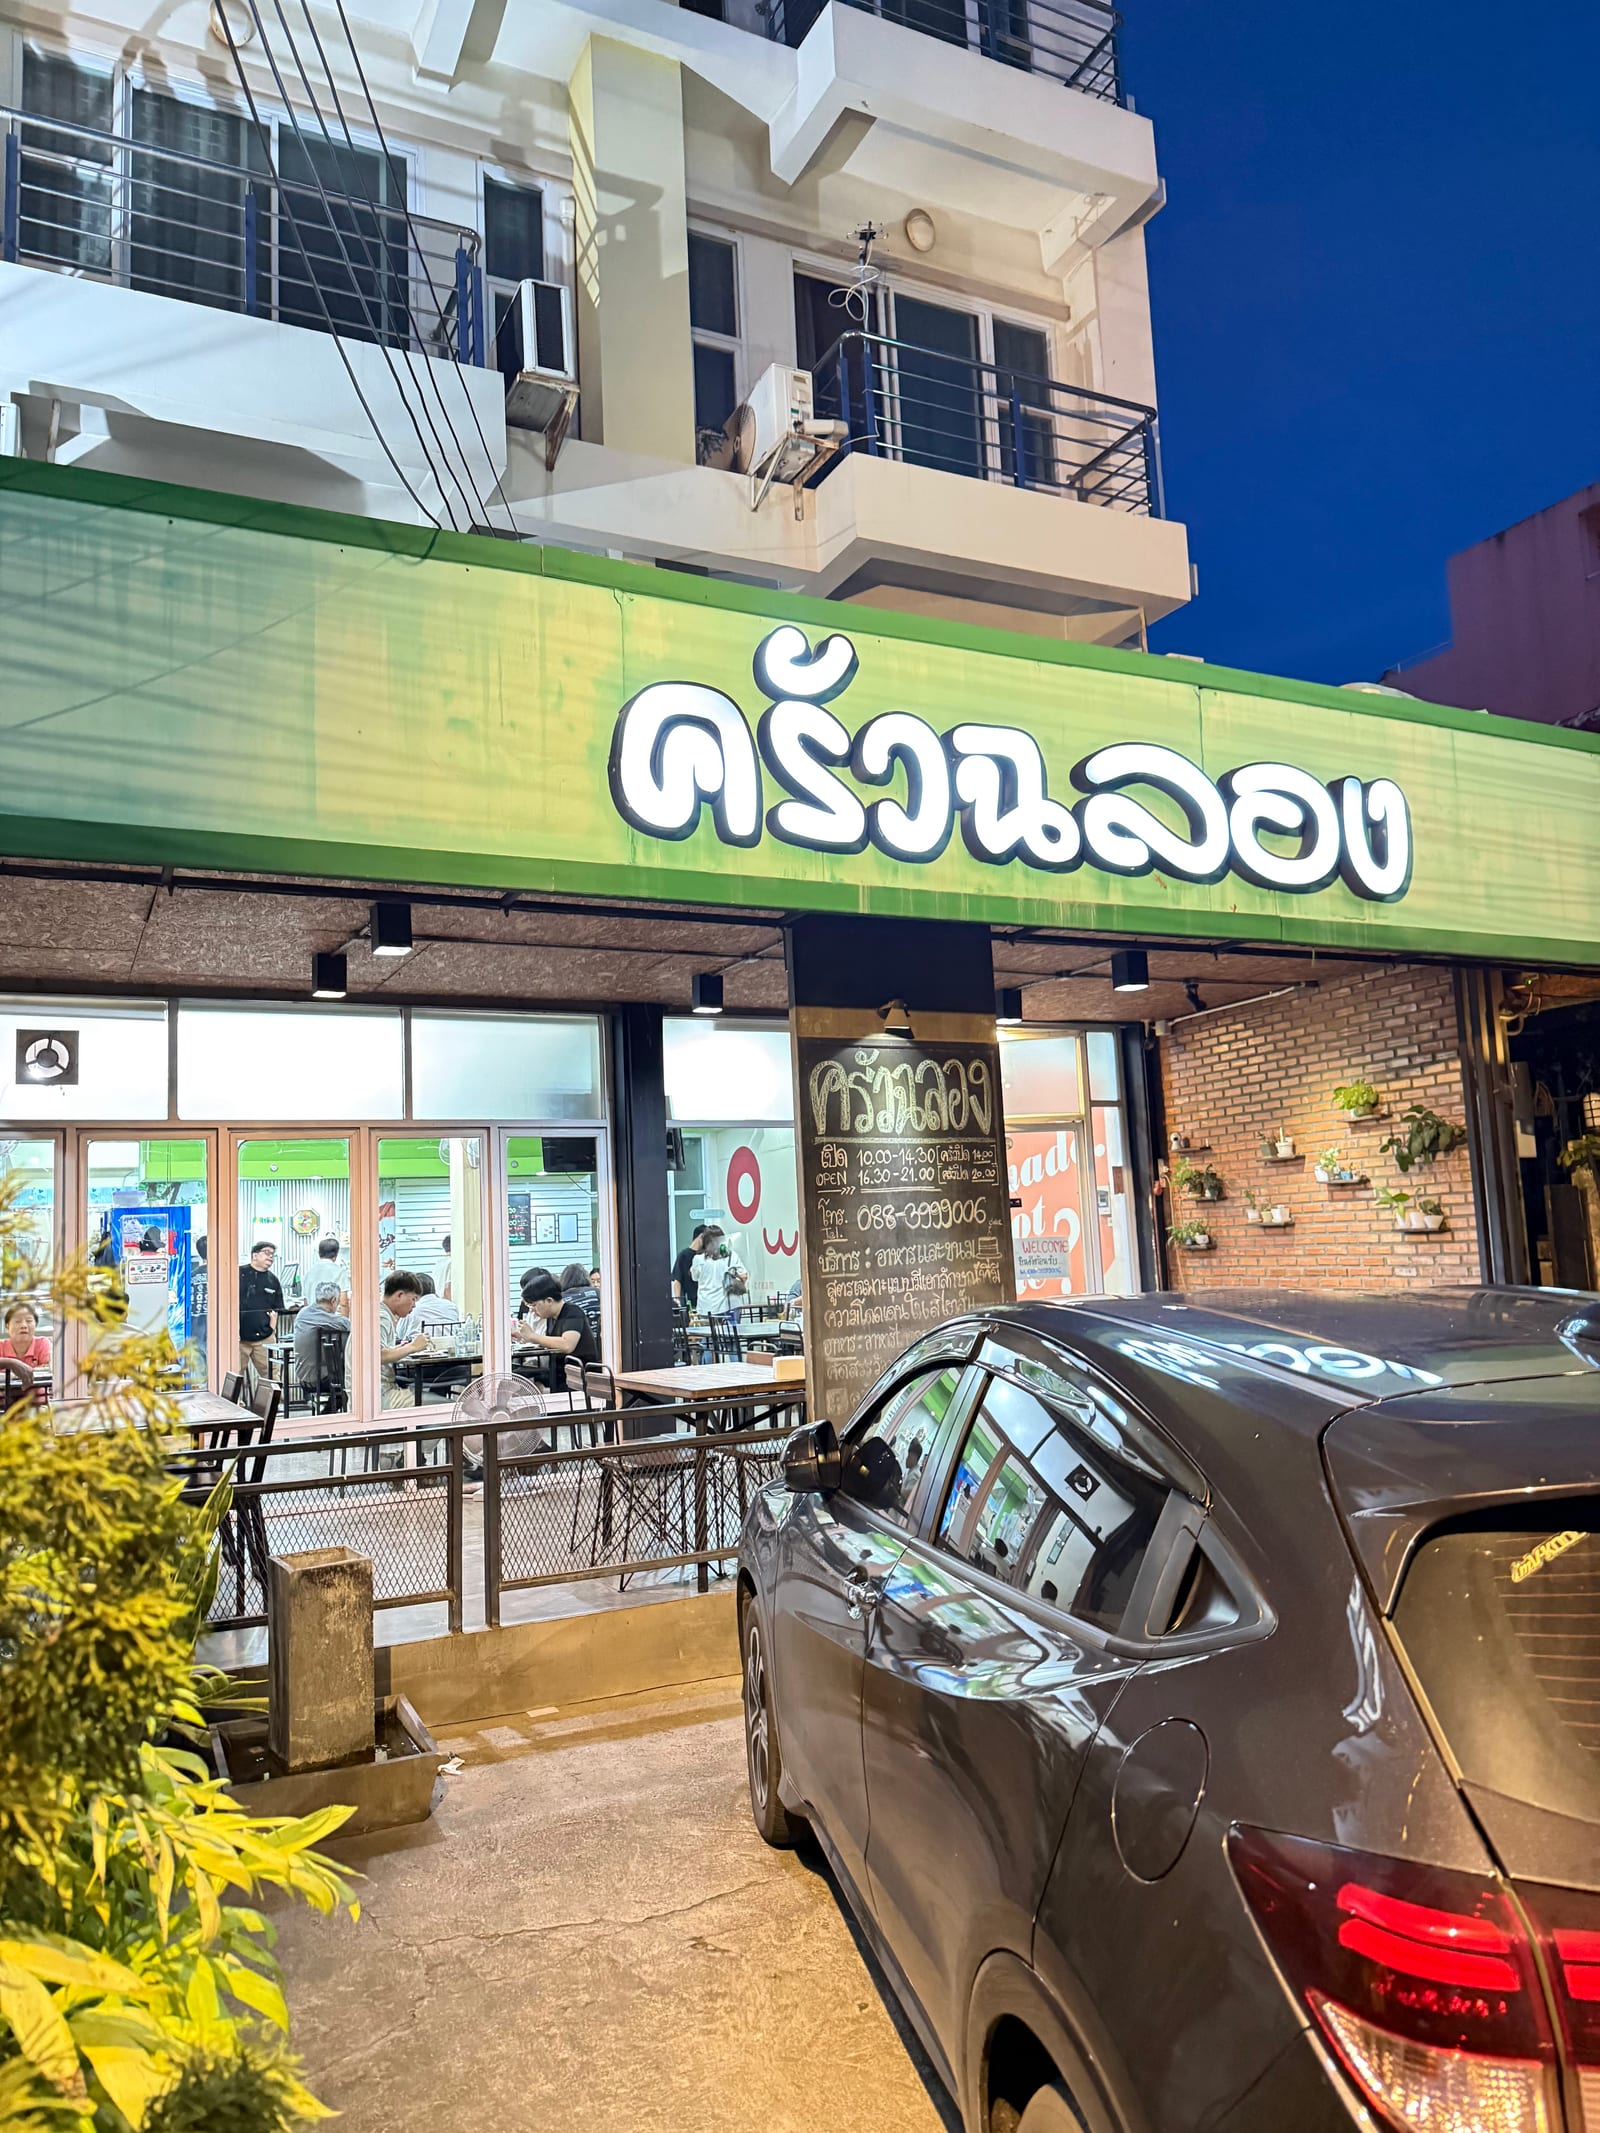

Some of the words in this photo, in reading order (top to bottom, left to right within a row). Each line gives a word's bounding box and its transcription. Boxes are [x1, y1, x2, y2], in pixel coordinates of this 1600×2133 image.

[608, 625, 1413, 904] ครัวฉลอง
[809, 1049, 993, 1136] ครัวฉลอง
[821, 1143, 848, 1168] เปิด
[857, 1197, 987, 1232] 088-3999006
[1022, 1240, 1069, 1253] WELCOME
